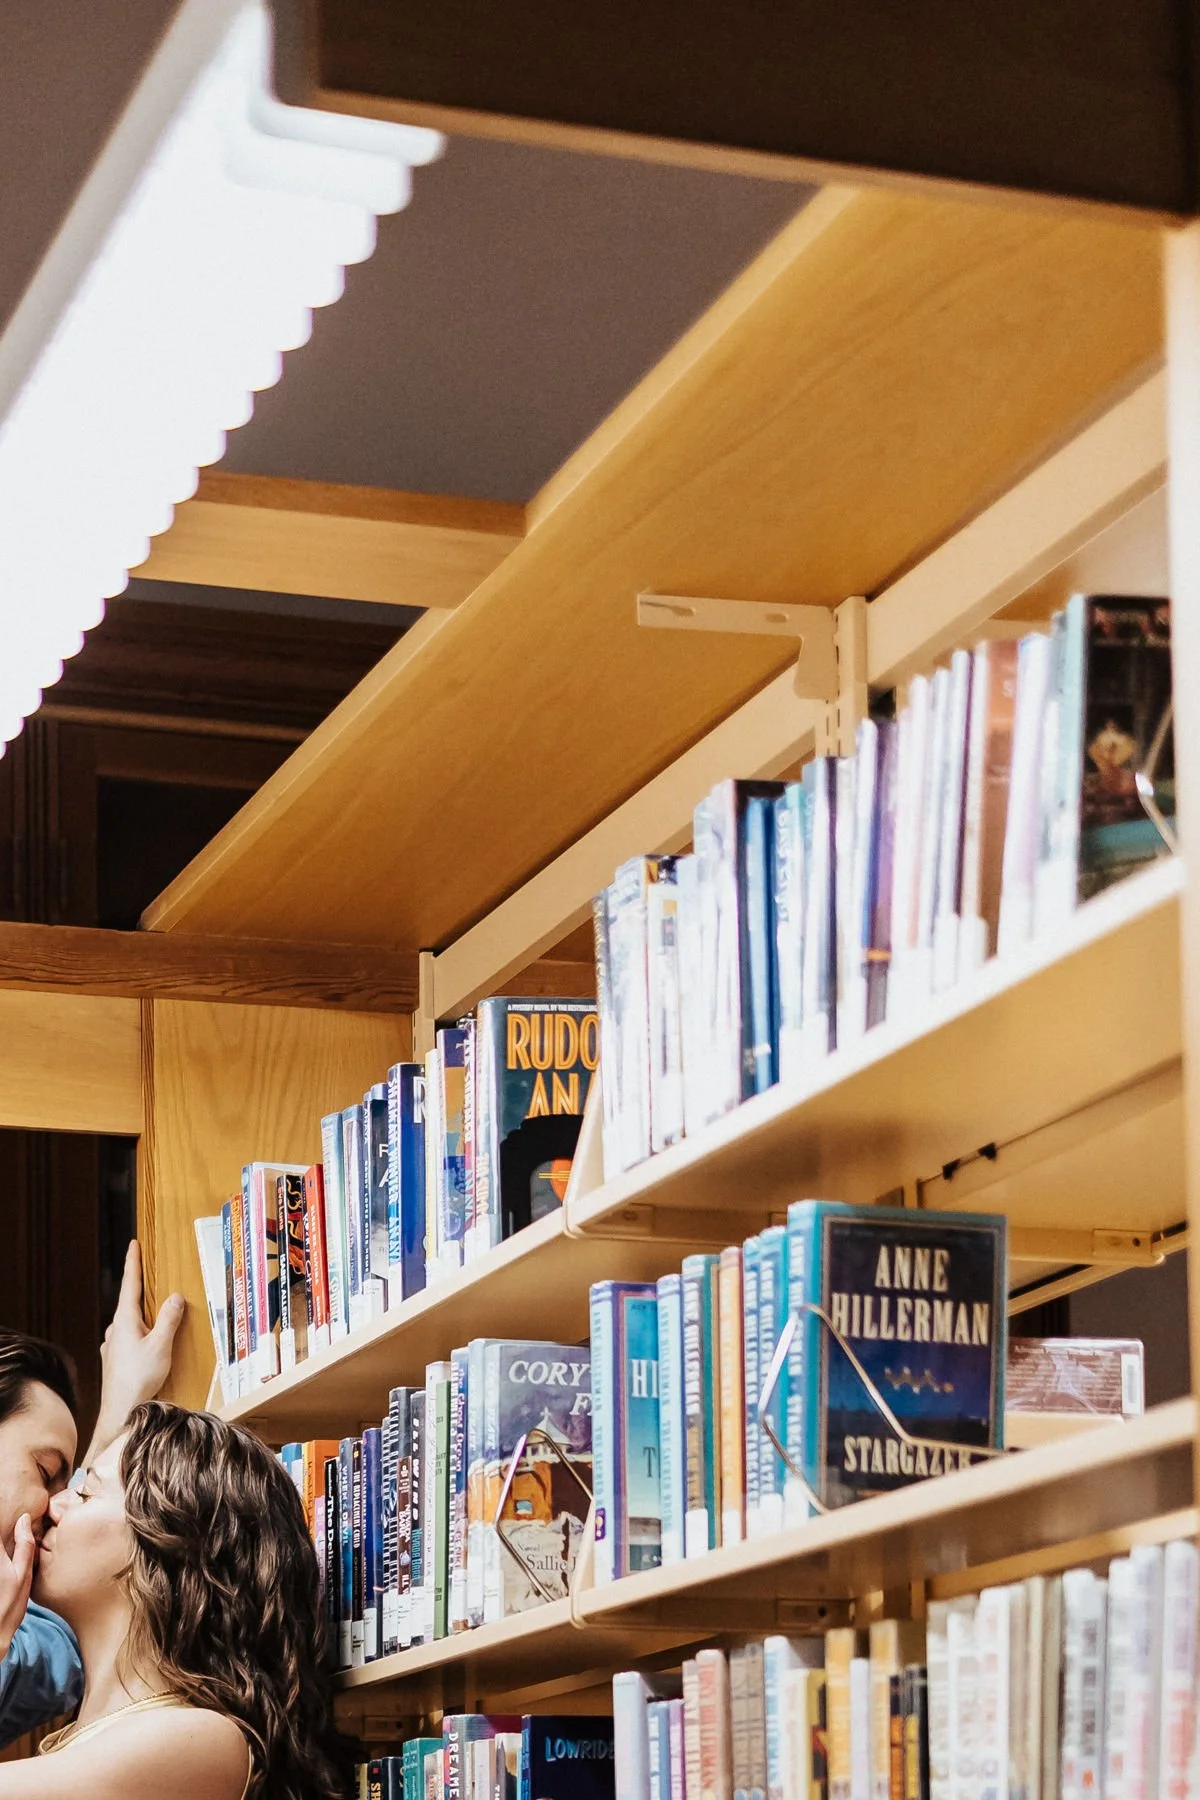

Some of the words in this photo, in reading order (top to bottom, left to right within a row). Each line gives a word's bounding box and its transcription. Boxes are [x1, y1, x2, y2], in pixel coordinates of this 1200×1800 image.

[506, 1012, 599, 1071] RUDO
[388, 1078, 398, 1146] SHAMAN
[277, 1186, 285, 1205] Eva
[388, 1149, 399, 1204] WINTER
[231, 1198, 242, 1240] EDWARD
[233, 1240, 243, 1270] ABBEY
[279, 1253, 287, 1288] ISABEL
[874, 1244, 951, 1293] ANNE
[235, 1275, 245, 1320] HAYDUKE
[246, 1277, 254, 1319] ALBERT
[236, 1321, 246, 1351] LIVES!
[831, 1291, 990, 1346] HILLERMAN
[456, 1392, 467, 1429] Ghost
[412, 1417, 420, 1453] ILL
[455, 1433, 466, 1472] Ocean
[353, 1470, 361, 1484] THE
[412, 1458, 420, 1521] WIND
[327, 1495, 335, 1528] The
[353, 1484, 361, 1528] REPLACEMENT
[353, 1529, 361, 1549] CHILD
[525, 1554, 569, 1571] Sallie
